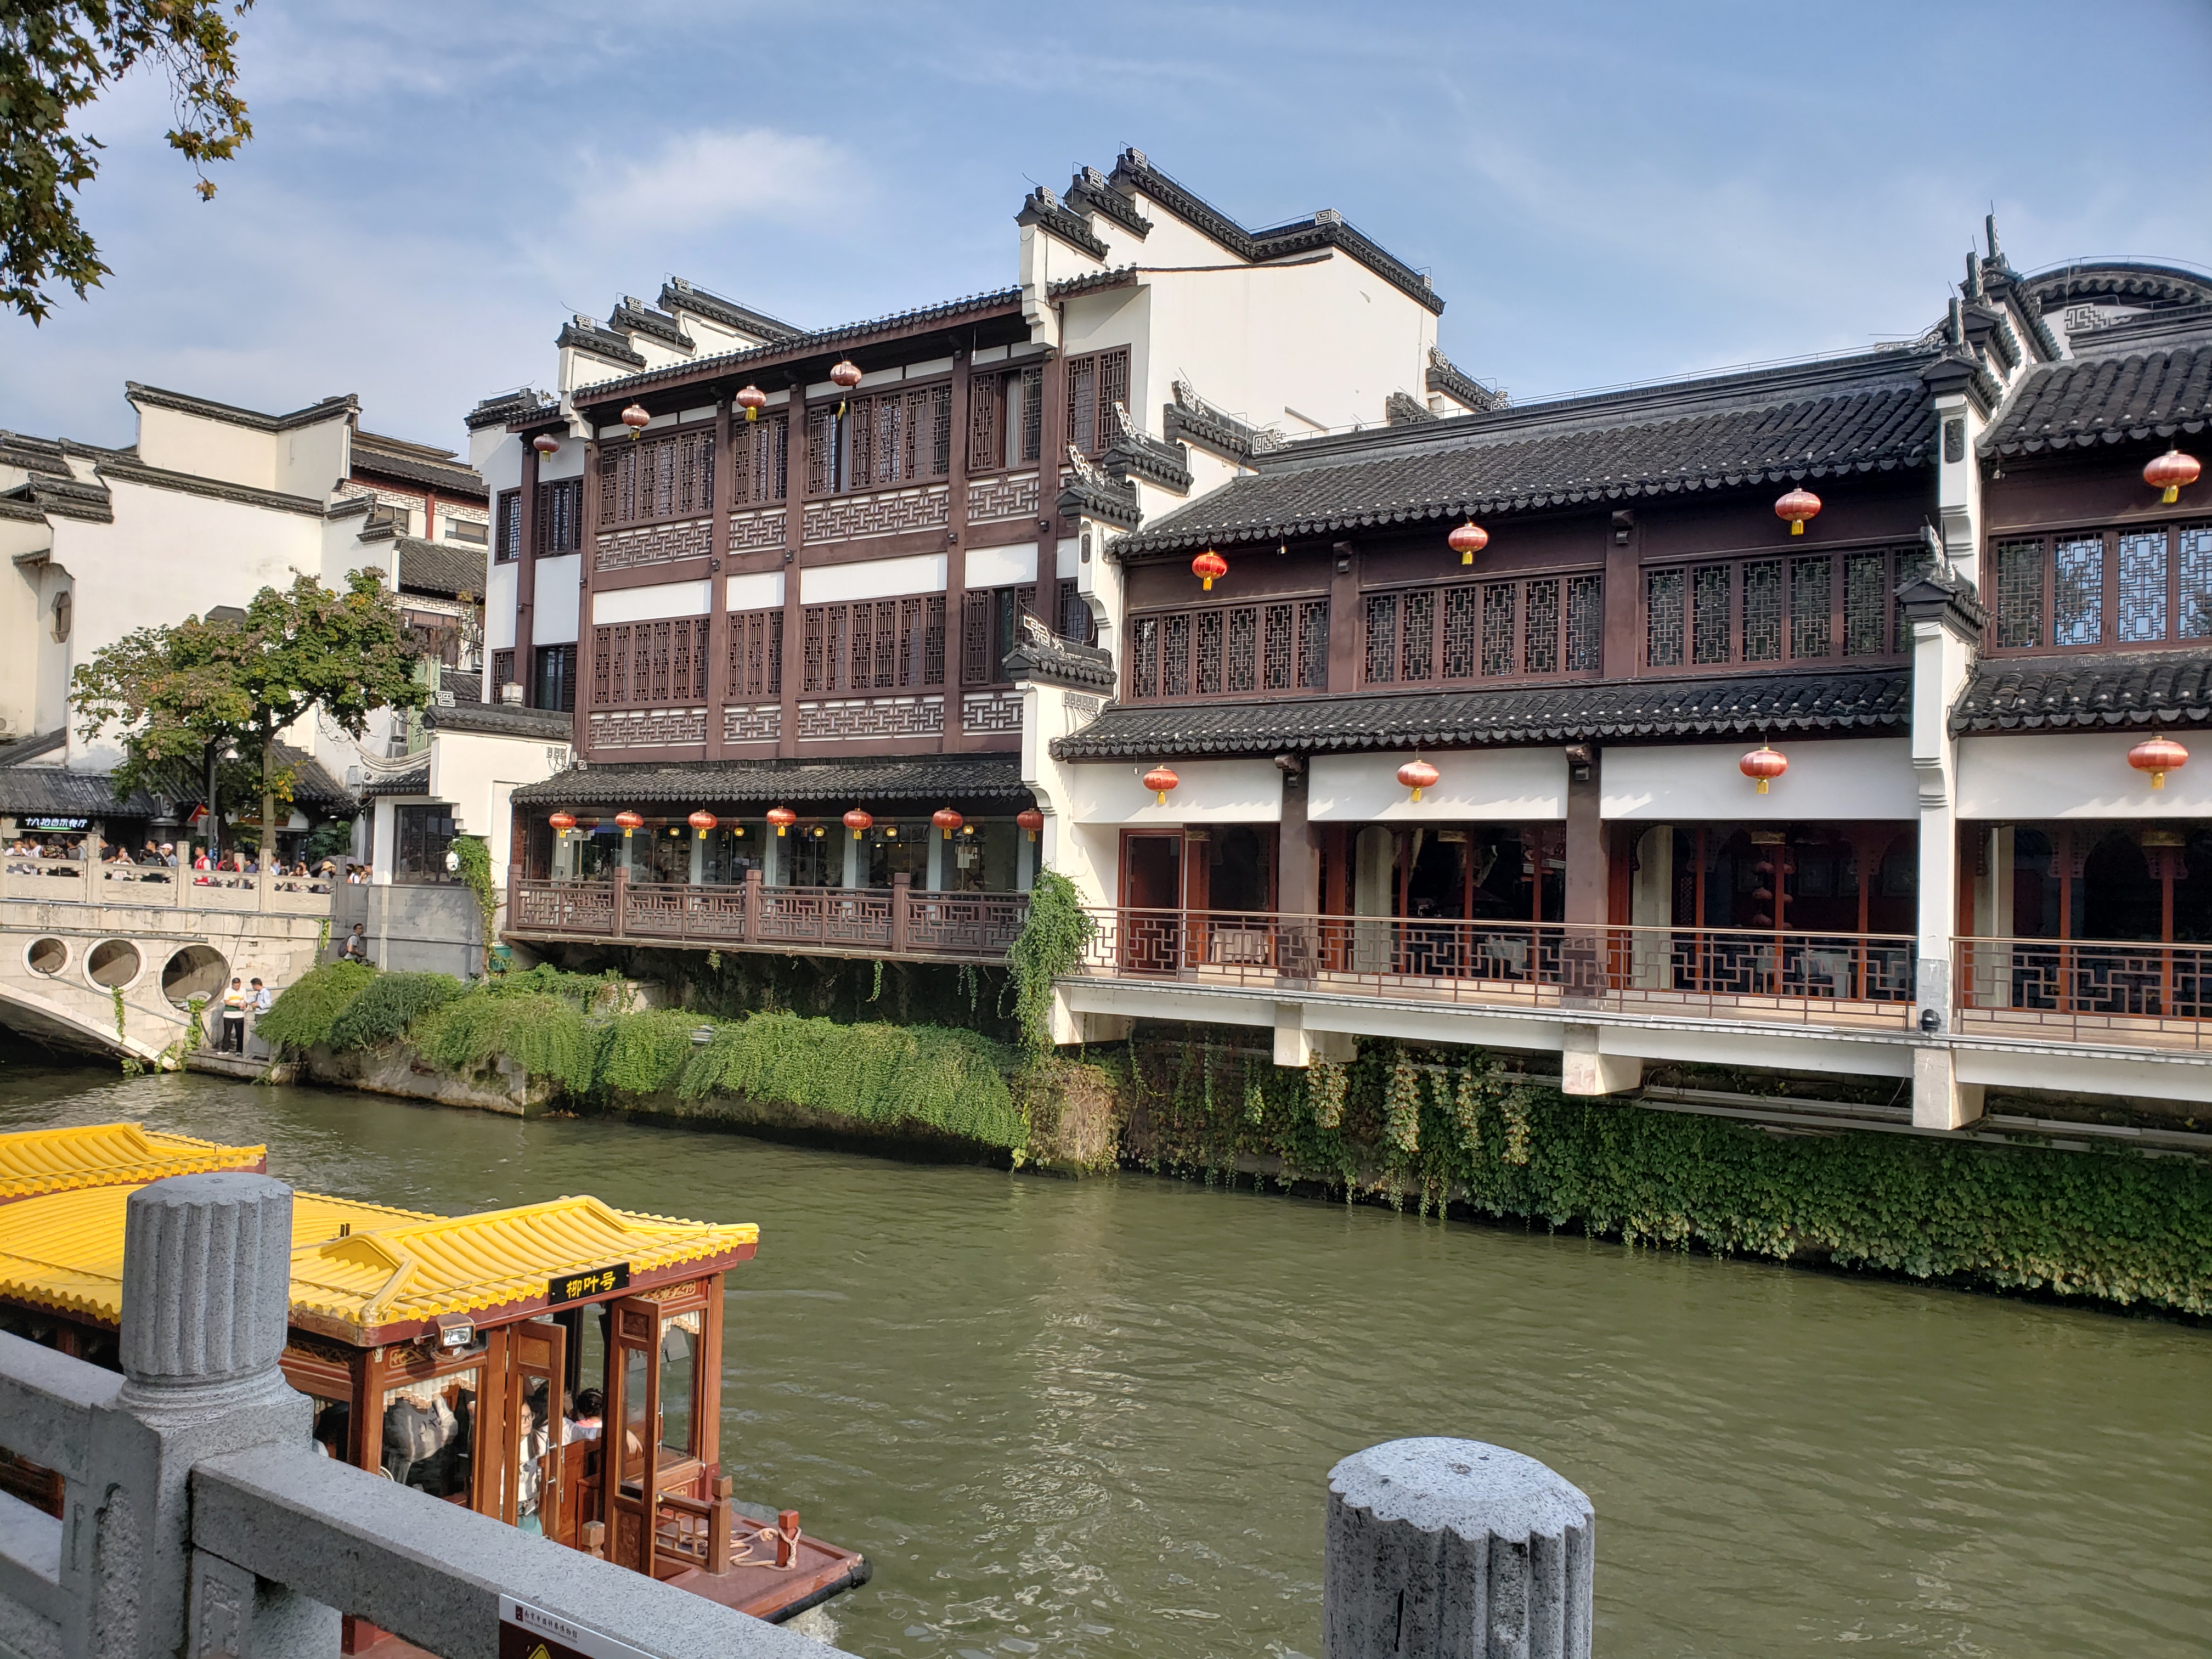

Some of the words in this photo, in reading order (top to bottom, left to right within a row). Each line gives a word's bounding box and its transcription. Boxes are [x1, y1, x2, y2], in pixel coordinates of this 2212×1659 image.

[25, 817, 88, 828] 十八拍音乐餐厅
[566, 1271, 616, 1299] 柳叶号
